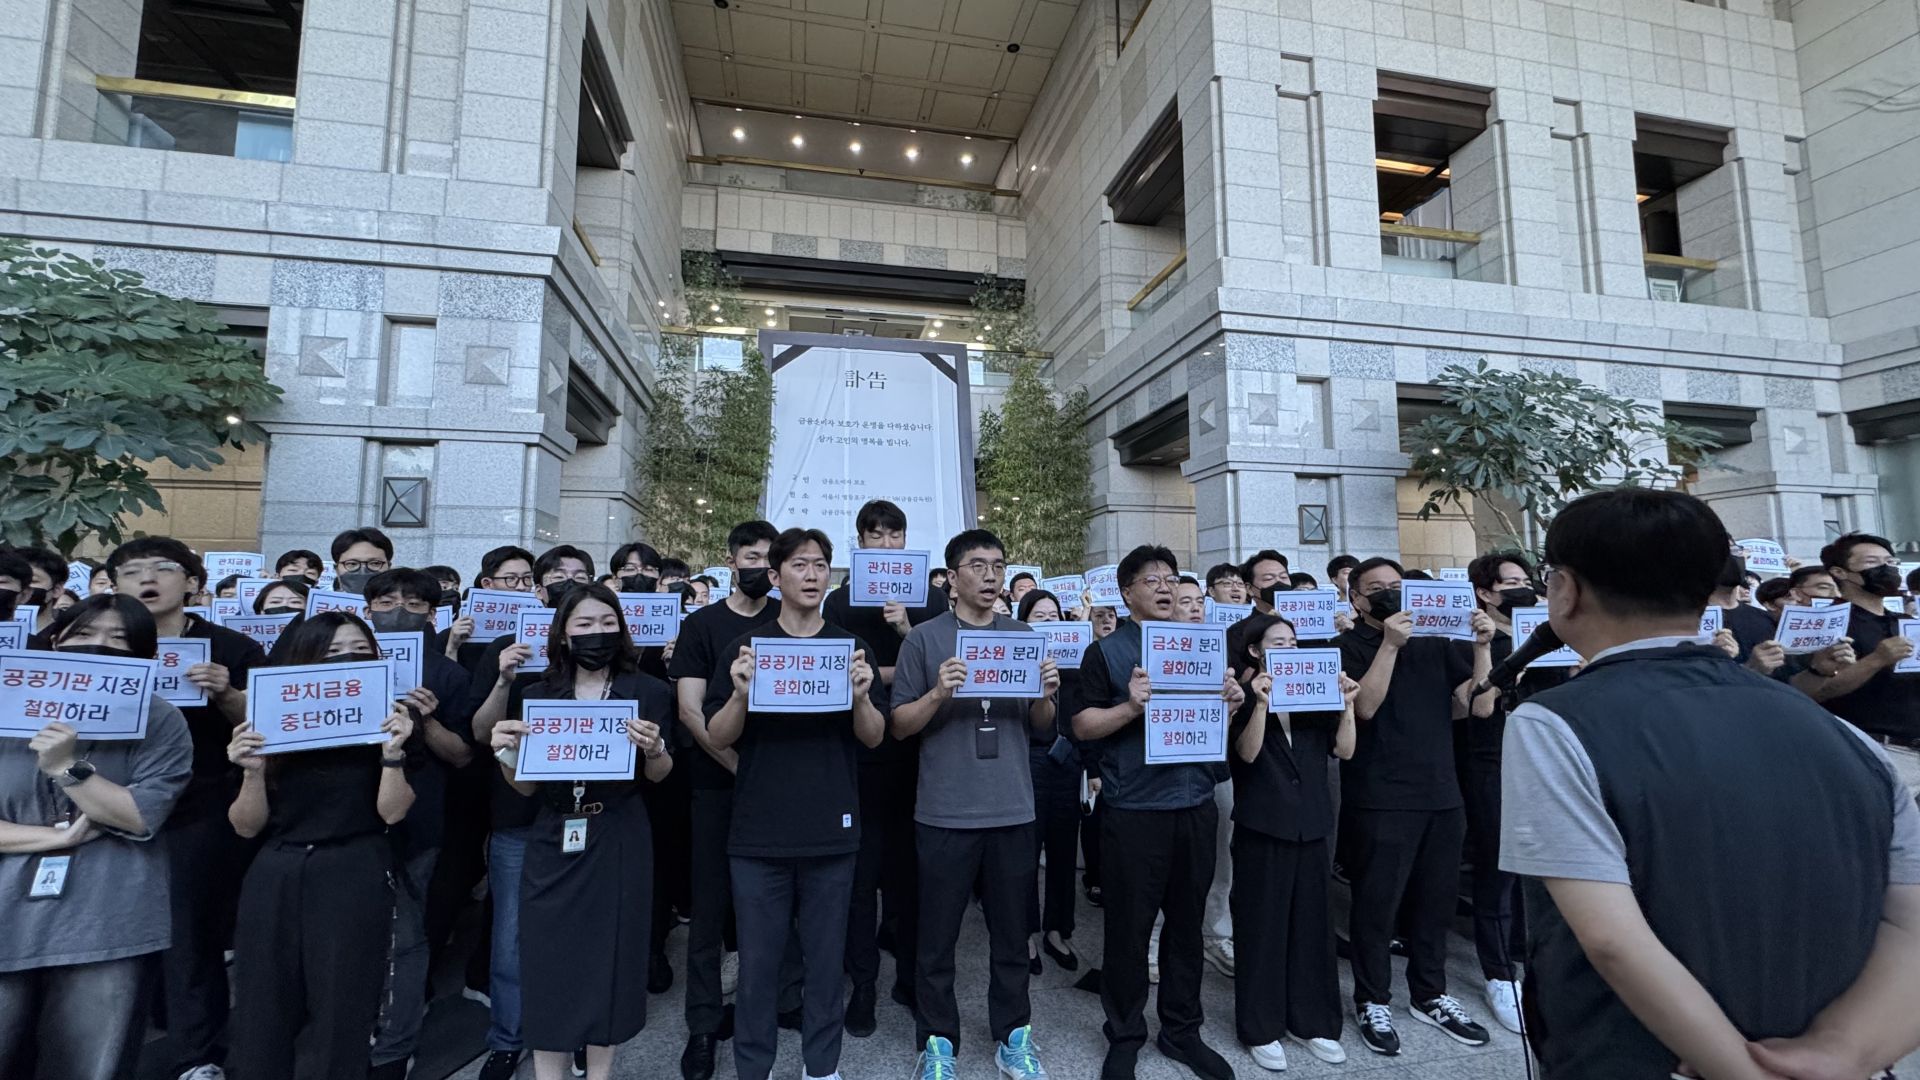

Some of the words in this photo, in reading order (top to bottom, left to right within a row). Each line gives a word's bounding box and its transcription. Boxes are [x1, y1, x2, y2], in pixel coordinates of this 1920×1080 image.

[844, 369, 888, 390] 訃告
[798, 416, 835, 428] 금융소비자
[837, 419, 860, 429] 보호가
[862, 421, 885, 430] 운명을
[886, 422, 934, 431] 다하셨습니다.
[818, 434, 833, 444] 삼가
[836, 436, 859, 446] 고인의
[861, 437, 884, 447] 명복을
[886, 438, 911, 448] 빕니다.
[218, 557, 252, 566] 관치금융
[867, 560, 913, 576] 관치금융
[867, 580, 913, 596] 중단하라
[1279, 600, 1315, 612] 공공기관
[1317, 600, 1333, 611] 지정
[1411, 593, 1446, 608] 금소원
[622, 604, 645, 617] 소원
[651, 604, 674, 617] 분리
[628, 623, 665, 636] 회하라
[1415, 614, 1463, 628] 철회하라
[1788, 617, 1825, 631] 금소원
[1827, 614, 1845, 630] 분리
[1152, 635, 1193, 652] 금소원
[1199, 637, 1221, 653] 분리
[1790, 634, 1835, 648] 철회하라
[965, 644, 1006, 661] 금소원
[1012, 644, 1039, 662] 분리
[758, 654, 815, 671] 공공기관
[819, 654, 846, 671] 지정
[1161, 659, 1212, 677] 철회하라
[1273, 662, 1315, 676] 공공기관
[1317, 661, 1338, 675] 지정
[2, 668, 93, 692] 공공기관
[97, 674, 141, 696] 지정
[972, 667, 1027, 686] 철회하라
[280, 678, 363, 703] 관치금융
[773, 678, 831, 696] 철회하라
[1284, 681, 1326, 697] 철회하라
[24, 699, 111, 722] 철회하라
[280, 706, 363, 732] 중단하라
[1150, 708, 1196, 724] 공공기관
[1199, 708, 1221, 723] 지정
[531, 717, 594, 735] 공공기관
[598, 718, 628, 735] 지정
[1162, 730, 1208, 747] 철회하라
[546, 743, 610, 762] 철회하라
